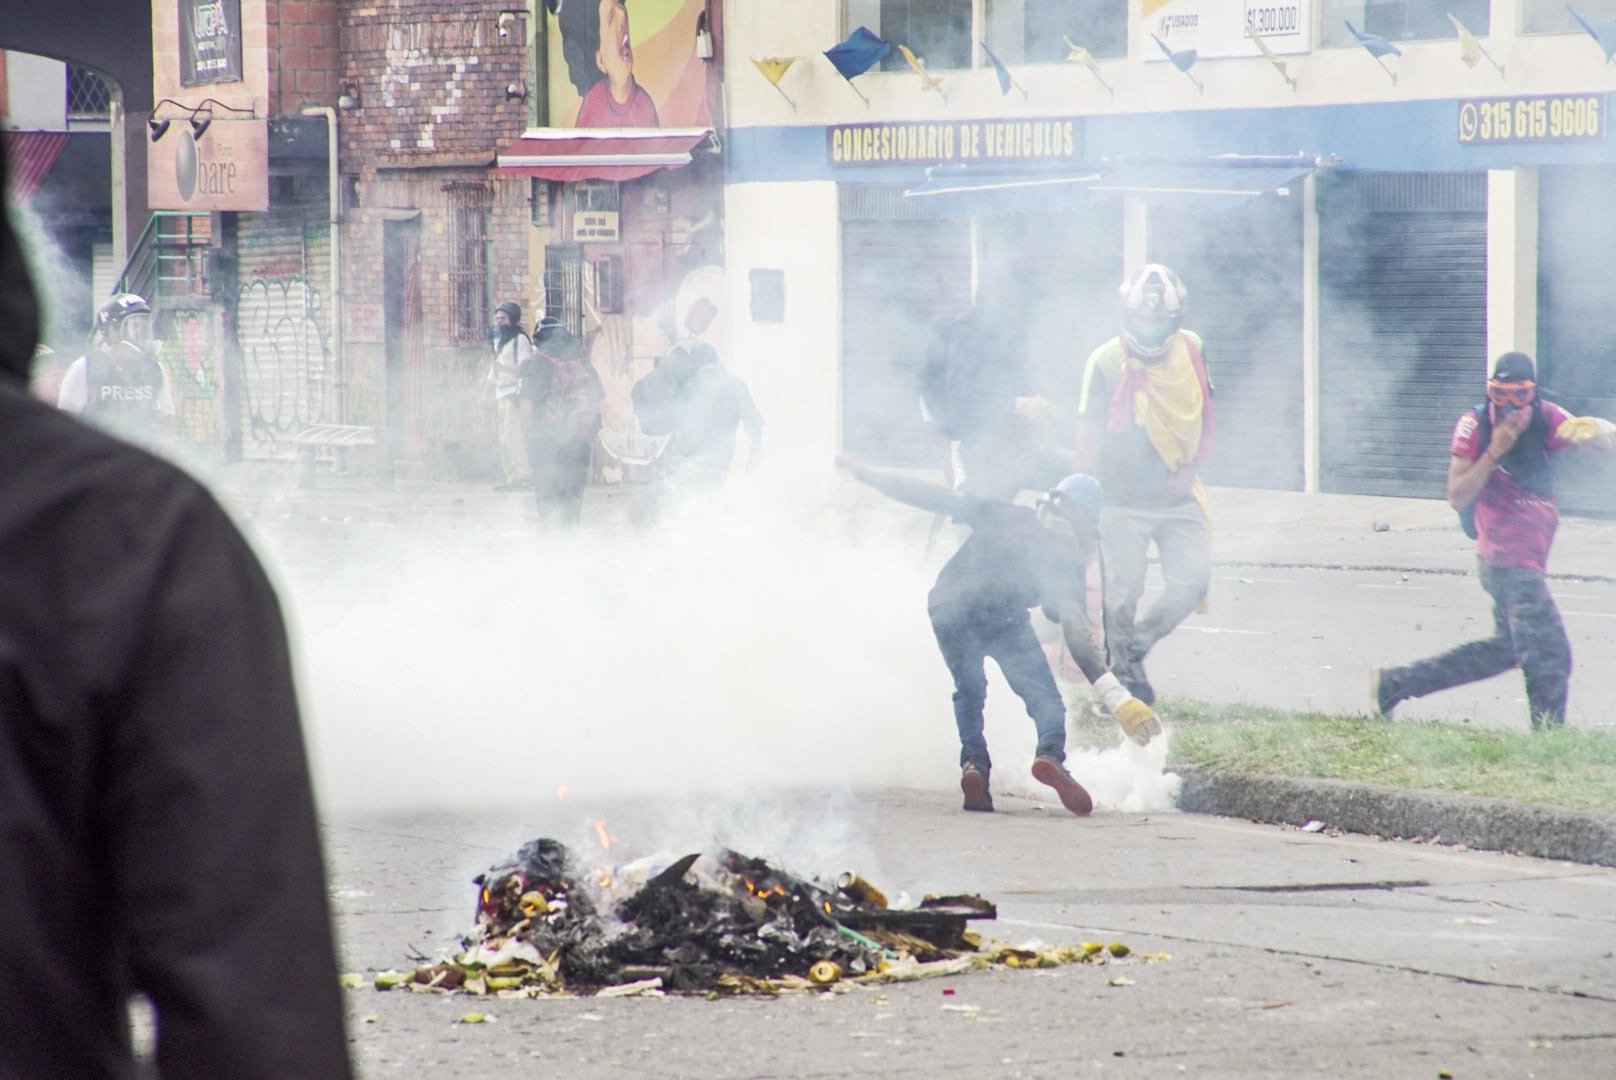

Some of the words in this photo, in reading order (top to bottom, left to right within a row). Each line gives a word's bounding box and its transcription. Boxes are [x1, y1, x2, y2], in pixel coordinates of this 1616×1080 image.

[1480, 101, 1512, 139] 315
[1515, 100, 1547, 138] 615
[1550, 97, 1599, 137] 9606
[833, 125, 954, 162] CONCESIONARIO
[960, 124, 979, 157] DE
[986, 121, 1073, 157] VEHICULOS
[101, 385, 153, 401] PRESS
